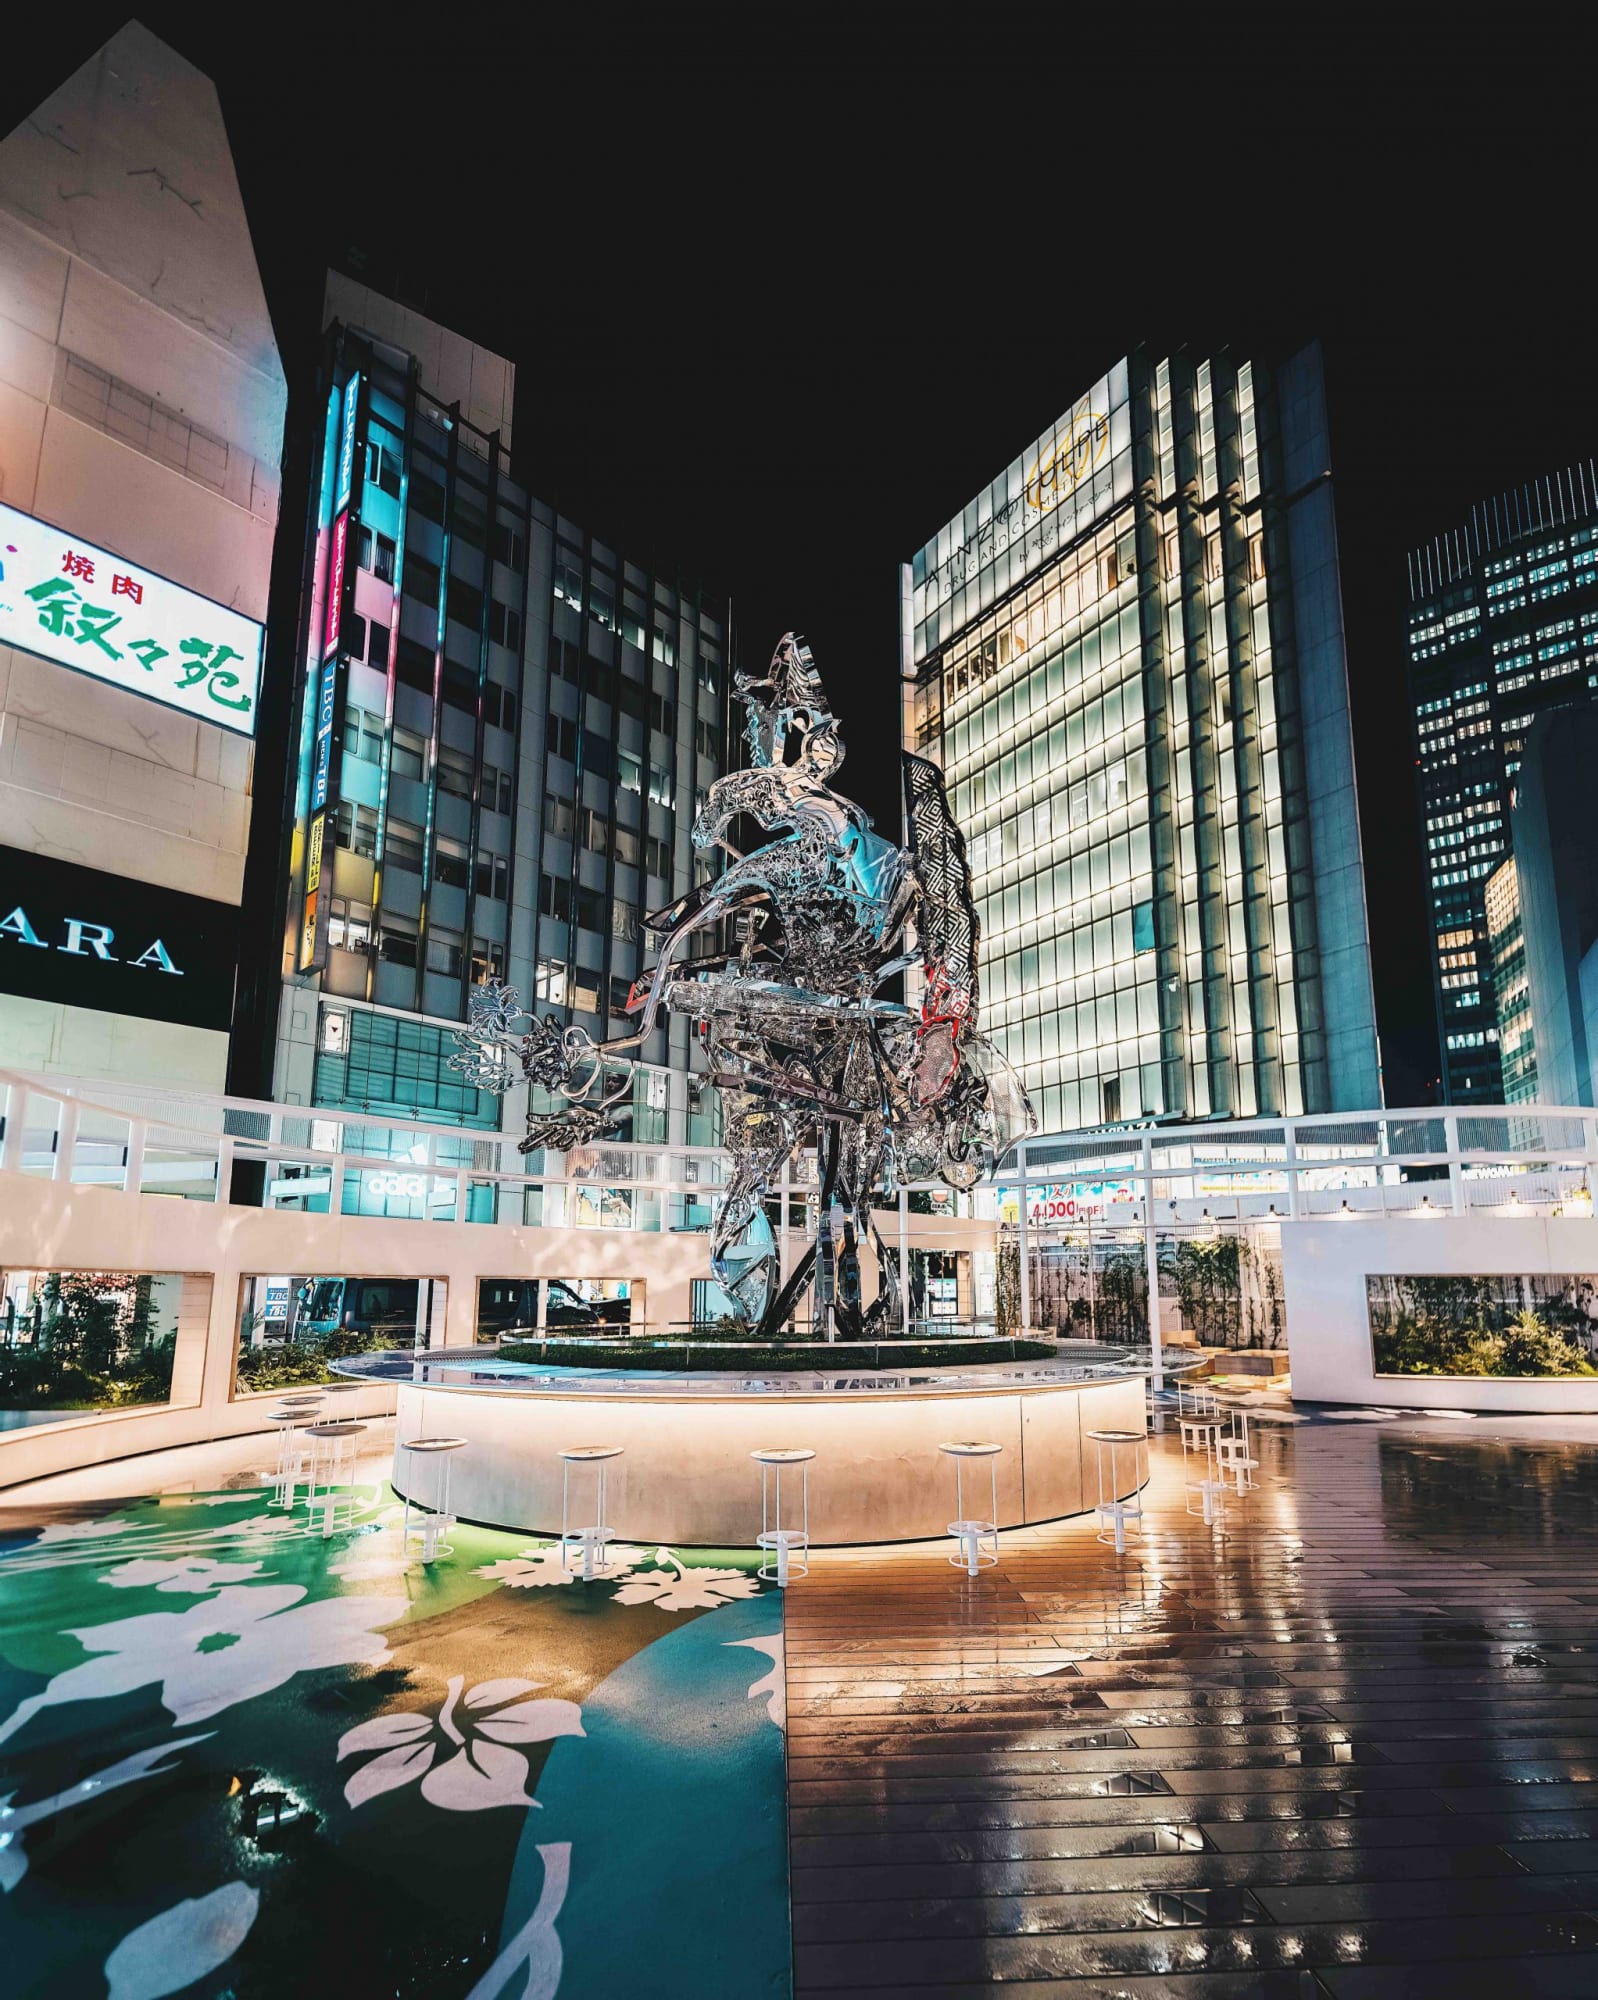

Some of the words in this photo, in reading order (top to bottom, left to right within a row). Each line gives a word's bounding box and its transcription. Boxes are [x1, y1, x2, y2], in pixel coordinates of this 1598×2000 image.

[925, 517, 993, 592] AINZ
[1021, 412, 1108, 503] TULPE
[944, 561, 976, 594] DRUG
[980, 534, 1007, 563] AND
[1012, 466, 1083, 535] COSMETIC
[62, 550, 143, 605] 焼肉
[25, 577, 252, 712] 叙々苑
[322, 667, 336, 722] TBC
[316, 765, 327, 805] TBC
[368, 1171, 450, 1197] adid
[269, 1292, 288, 1300] TBC
